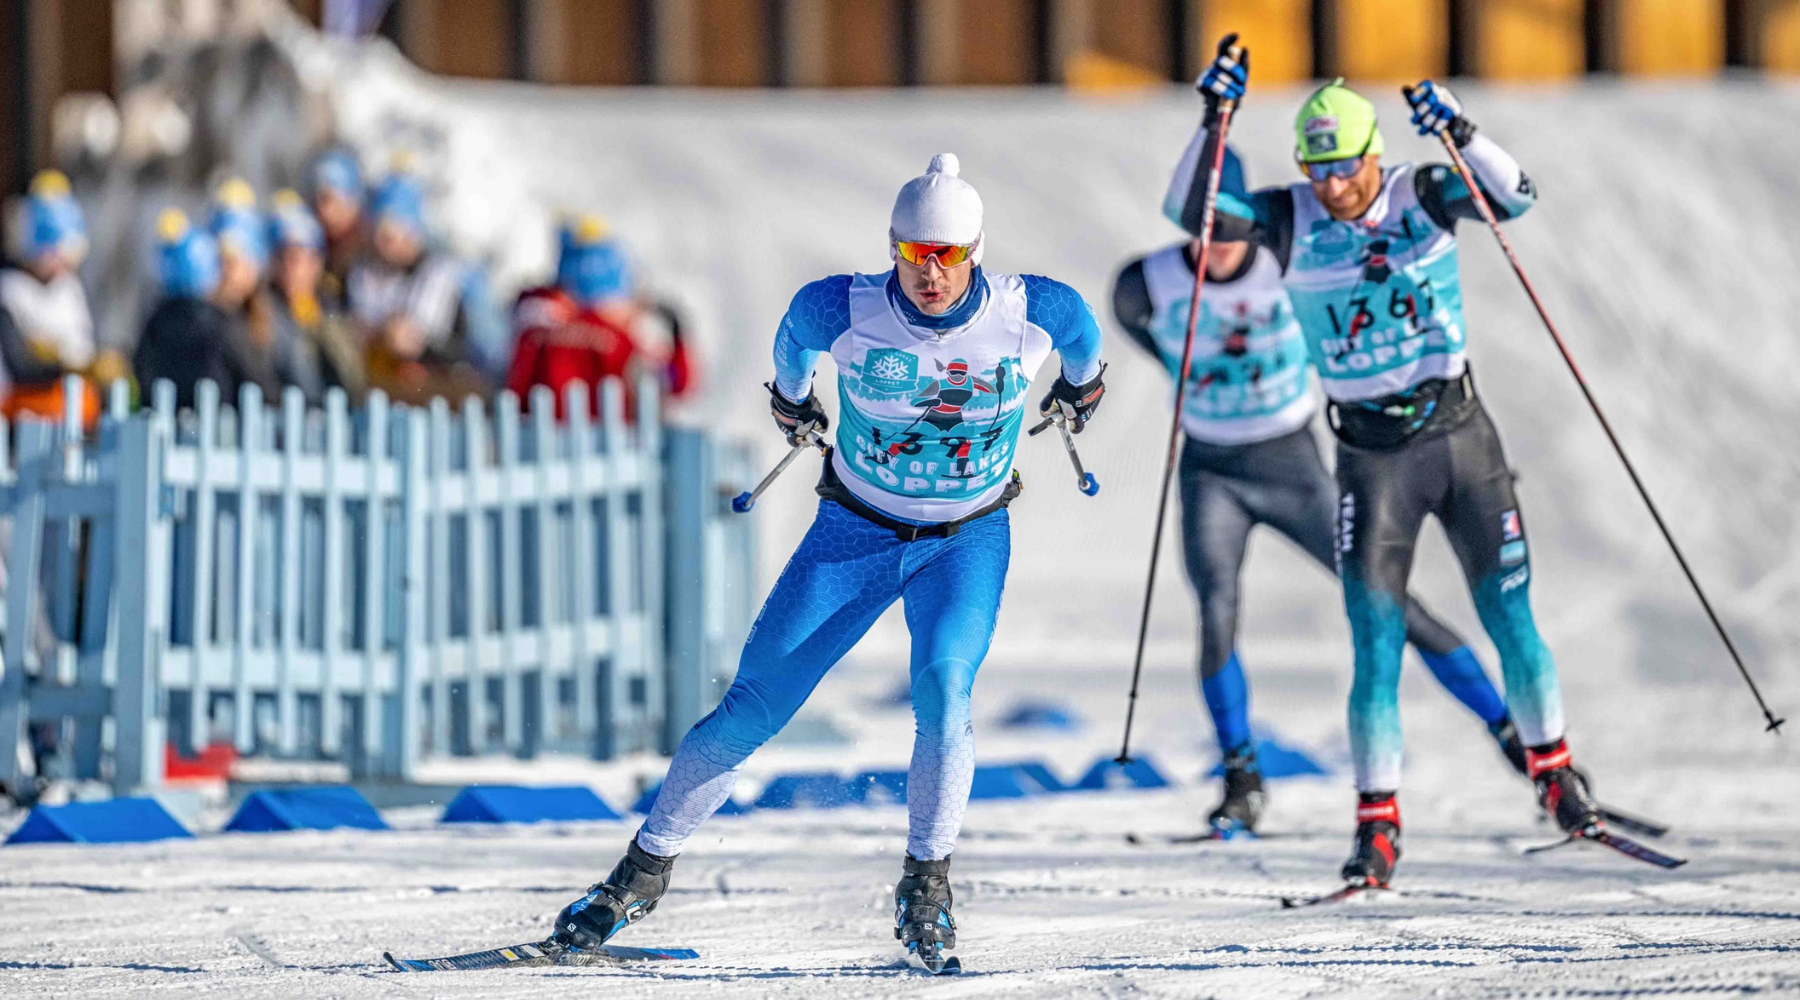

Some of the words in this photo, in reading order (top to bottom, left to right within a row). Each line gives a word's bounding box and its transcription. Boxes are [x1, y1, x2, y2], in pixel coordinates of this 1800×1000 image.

[855, 450, 1009, 492] LOPPET
[856, 434, 899, 470] CITY
[910, 461, 938, 475] OF
[949, 441, 1009, 476] LAKES
[1341, 492, 1355, 553] TEAM
